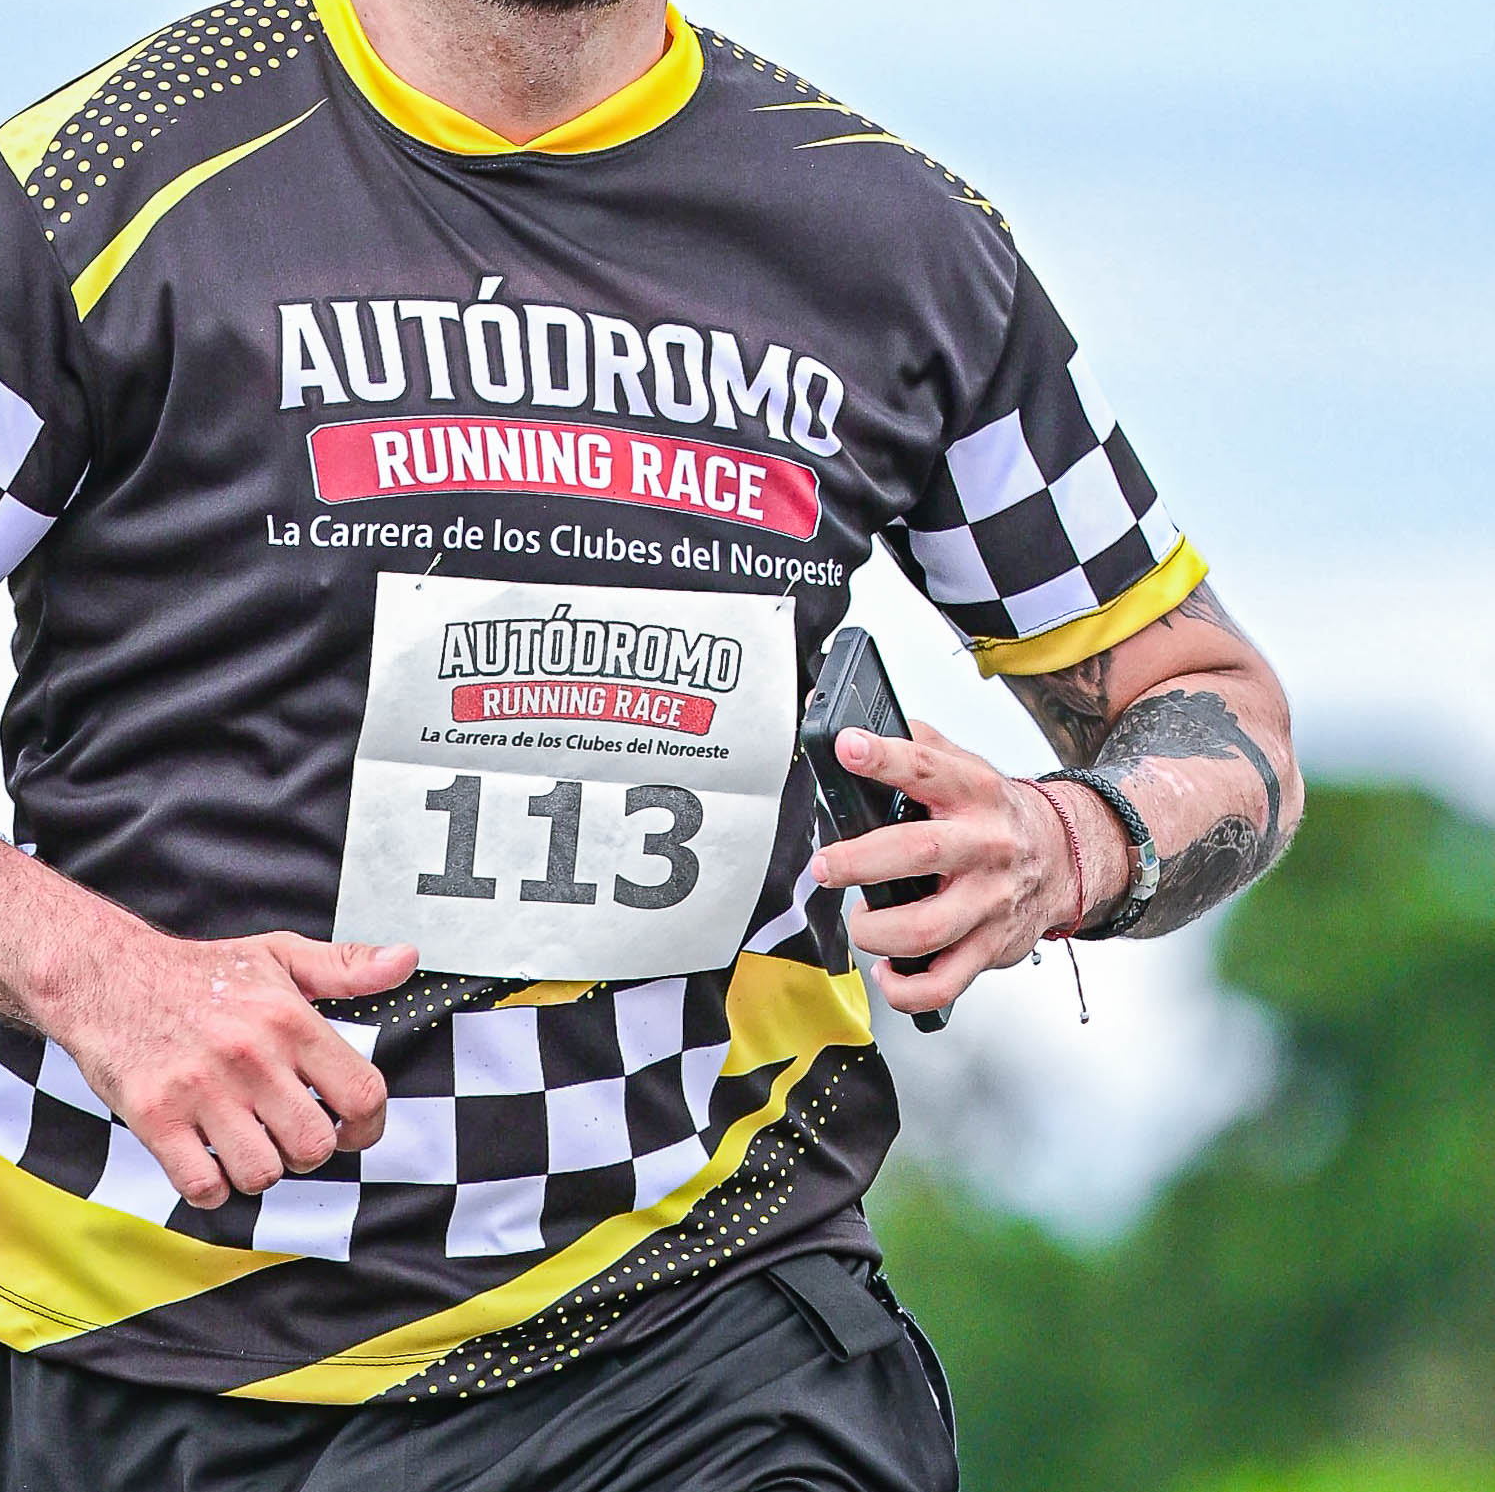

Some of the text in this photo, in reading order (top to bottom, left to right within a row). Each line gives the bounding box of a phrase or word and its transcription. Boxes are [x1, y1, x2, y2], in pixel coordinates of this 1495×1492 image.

[277, 275, 845, 458] AUTÓDROMO
[371, 426, 769, 521] RUNNING RACE
[266, 514, 843, 587] La Carrera de los Clubes del Noroeste
[437, 604, 743, 693] AUTÓDROMO
[420, 726, 730, 759] La Carrera de los Clubes del Noroeste
[482, 685, 687, 727] RUNNING RACE
[416, 774, 704, 909] 113
